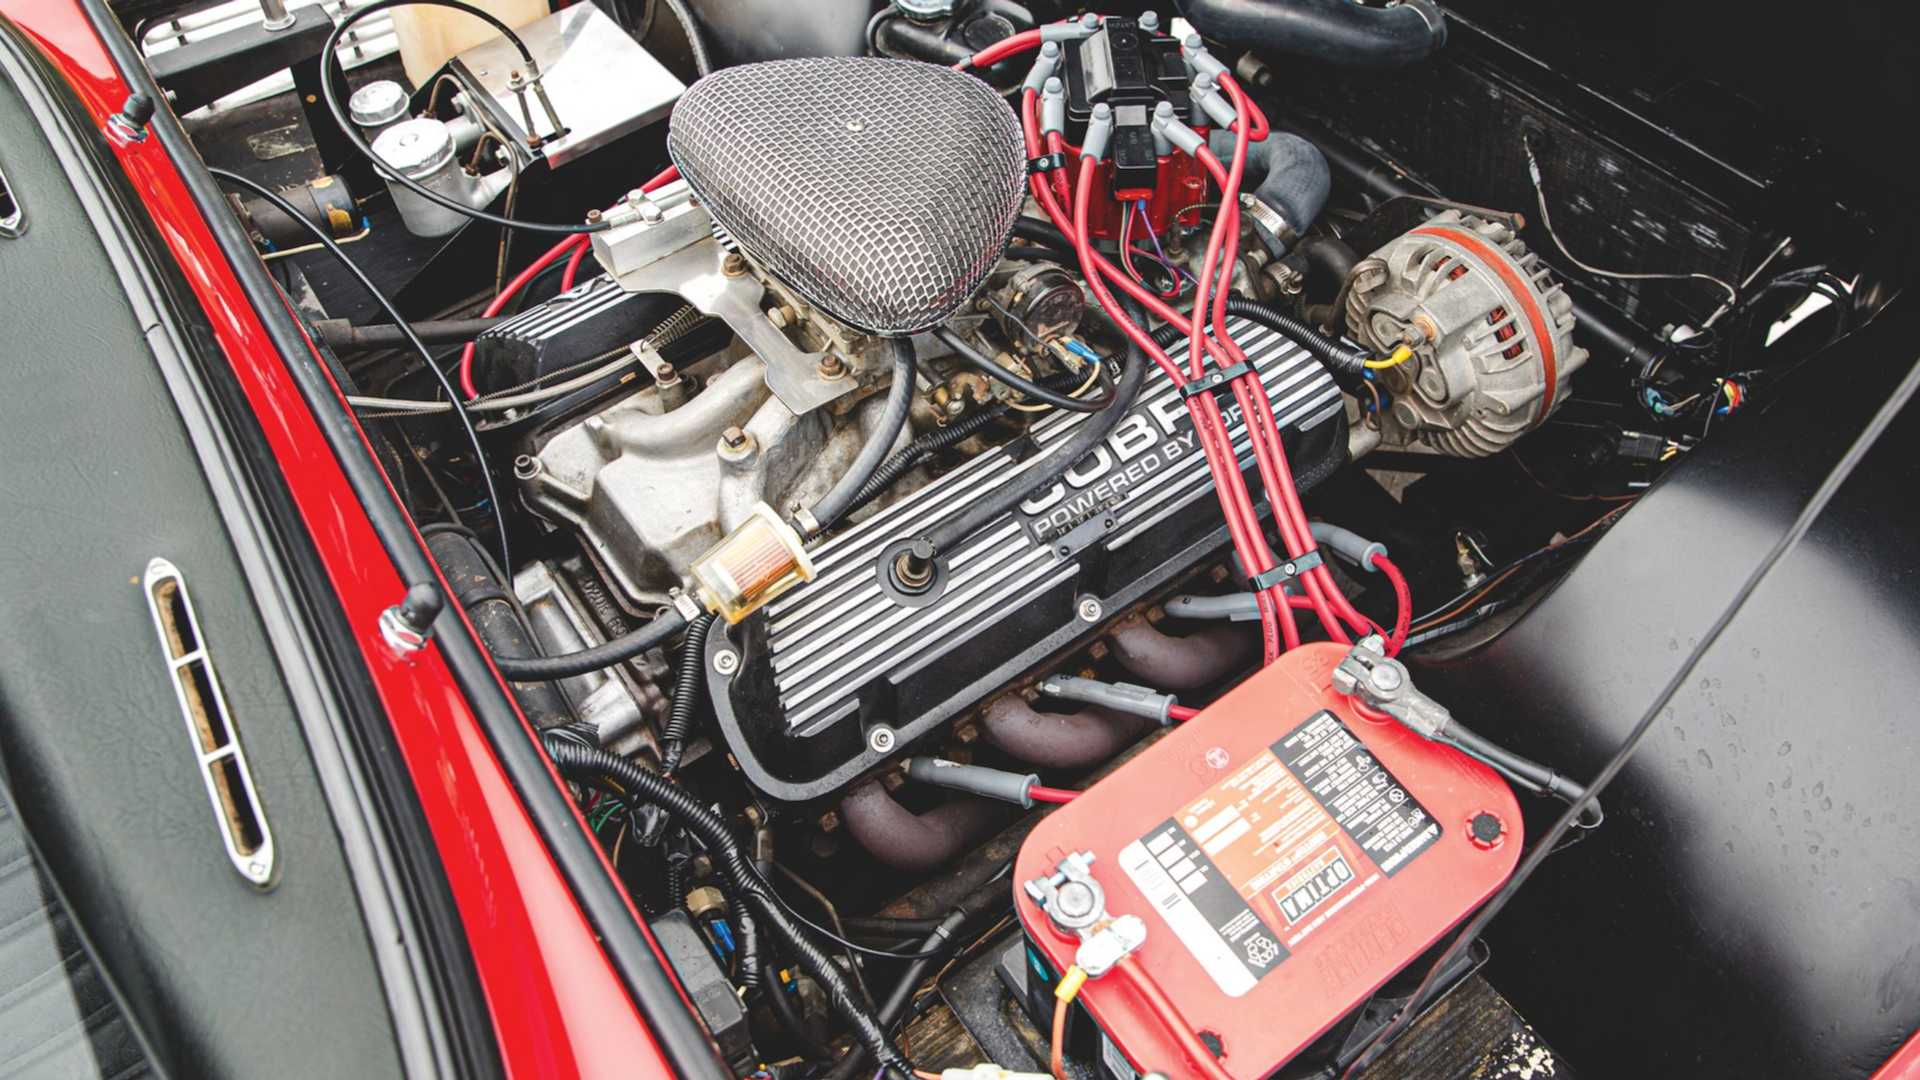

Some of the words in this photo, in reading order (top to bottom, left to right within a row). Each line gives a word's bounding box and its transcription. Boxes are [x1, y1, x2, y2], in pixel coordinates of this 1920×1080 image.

[1033, 456, 1161, 539] POWERED
[1163, 431, 1196, 460] BY
[1281, 858, 1351, 920] OPTIMA
